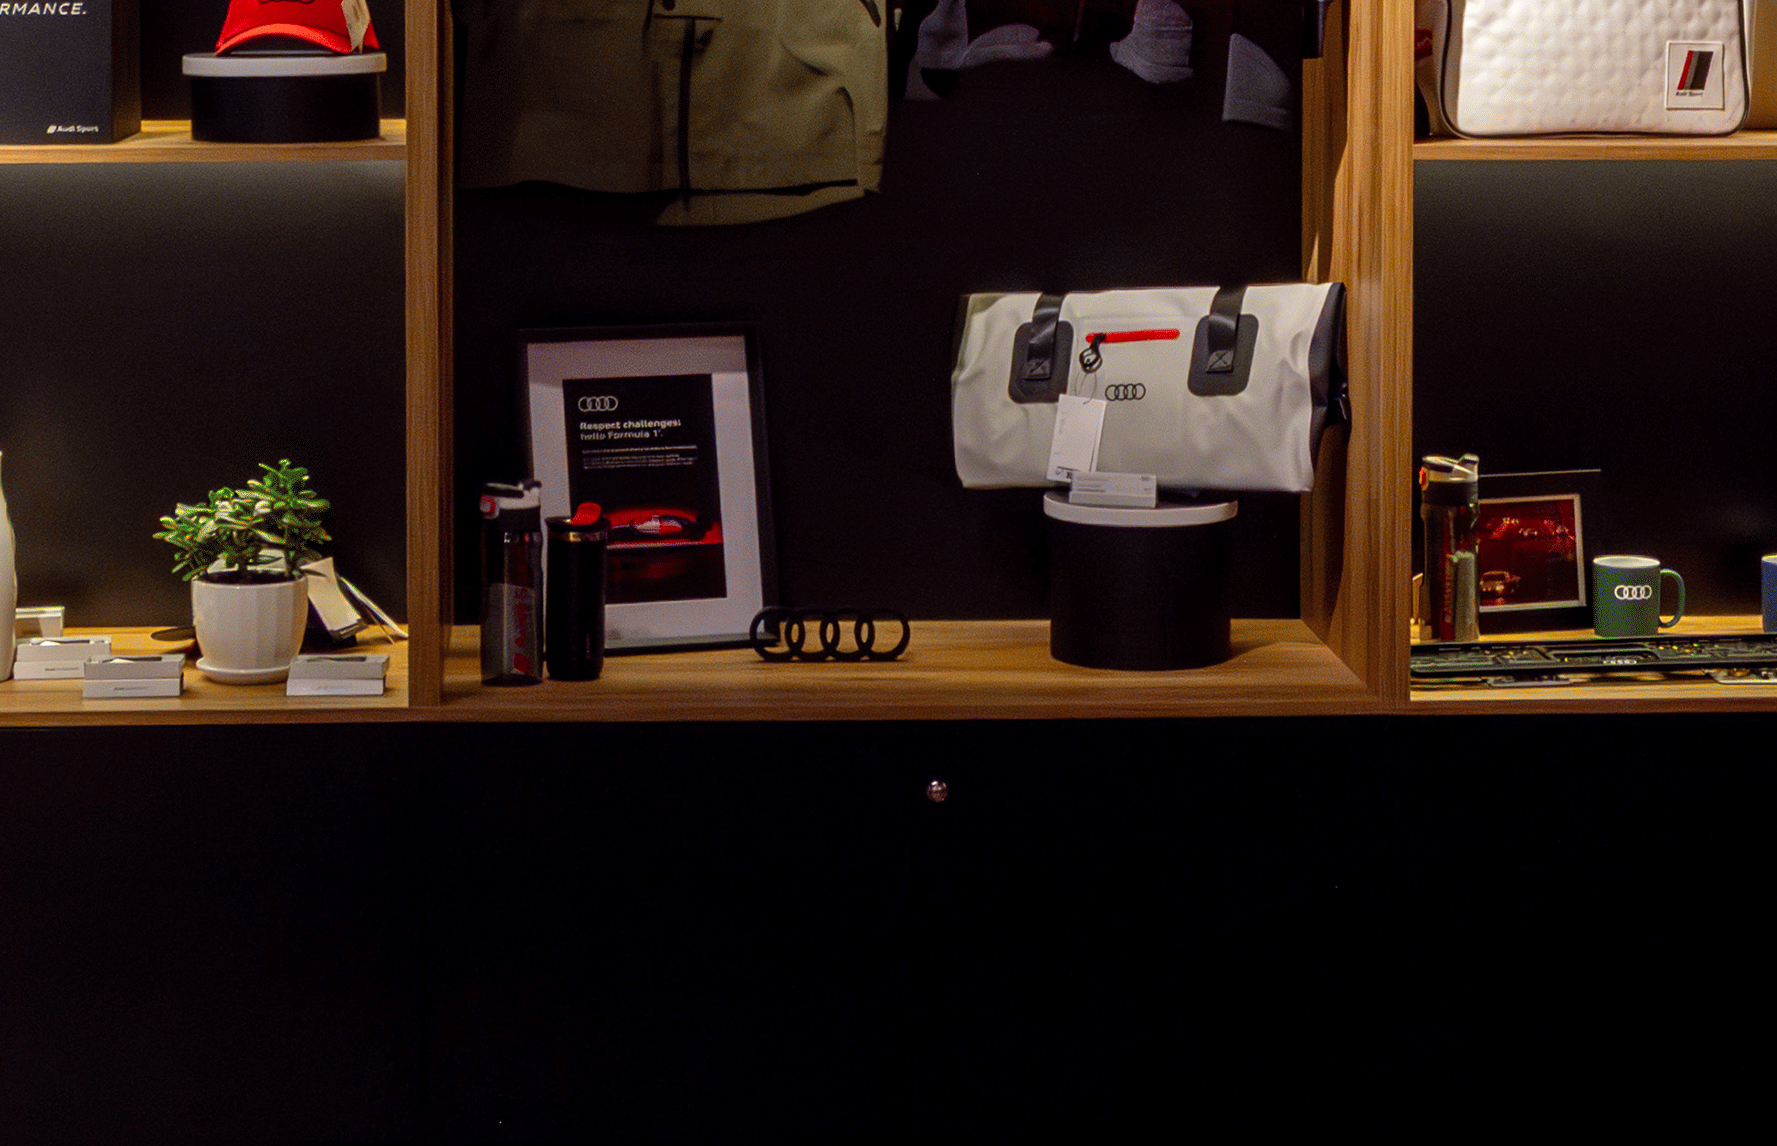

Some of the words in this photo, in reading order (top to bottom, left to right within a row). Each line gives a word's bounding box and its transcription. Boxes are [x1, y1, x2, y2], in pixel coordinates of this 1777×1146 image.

[57, 125, 75, 133] Audi
[76, 125, 99, 134] Sport
[580, 421, 621, 432] Respect
[581, 432, 606, 441] hello
[608, 430, 650, 440] Formula
